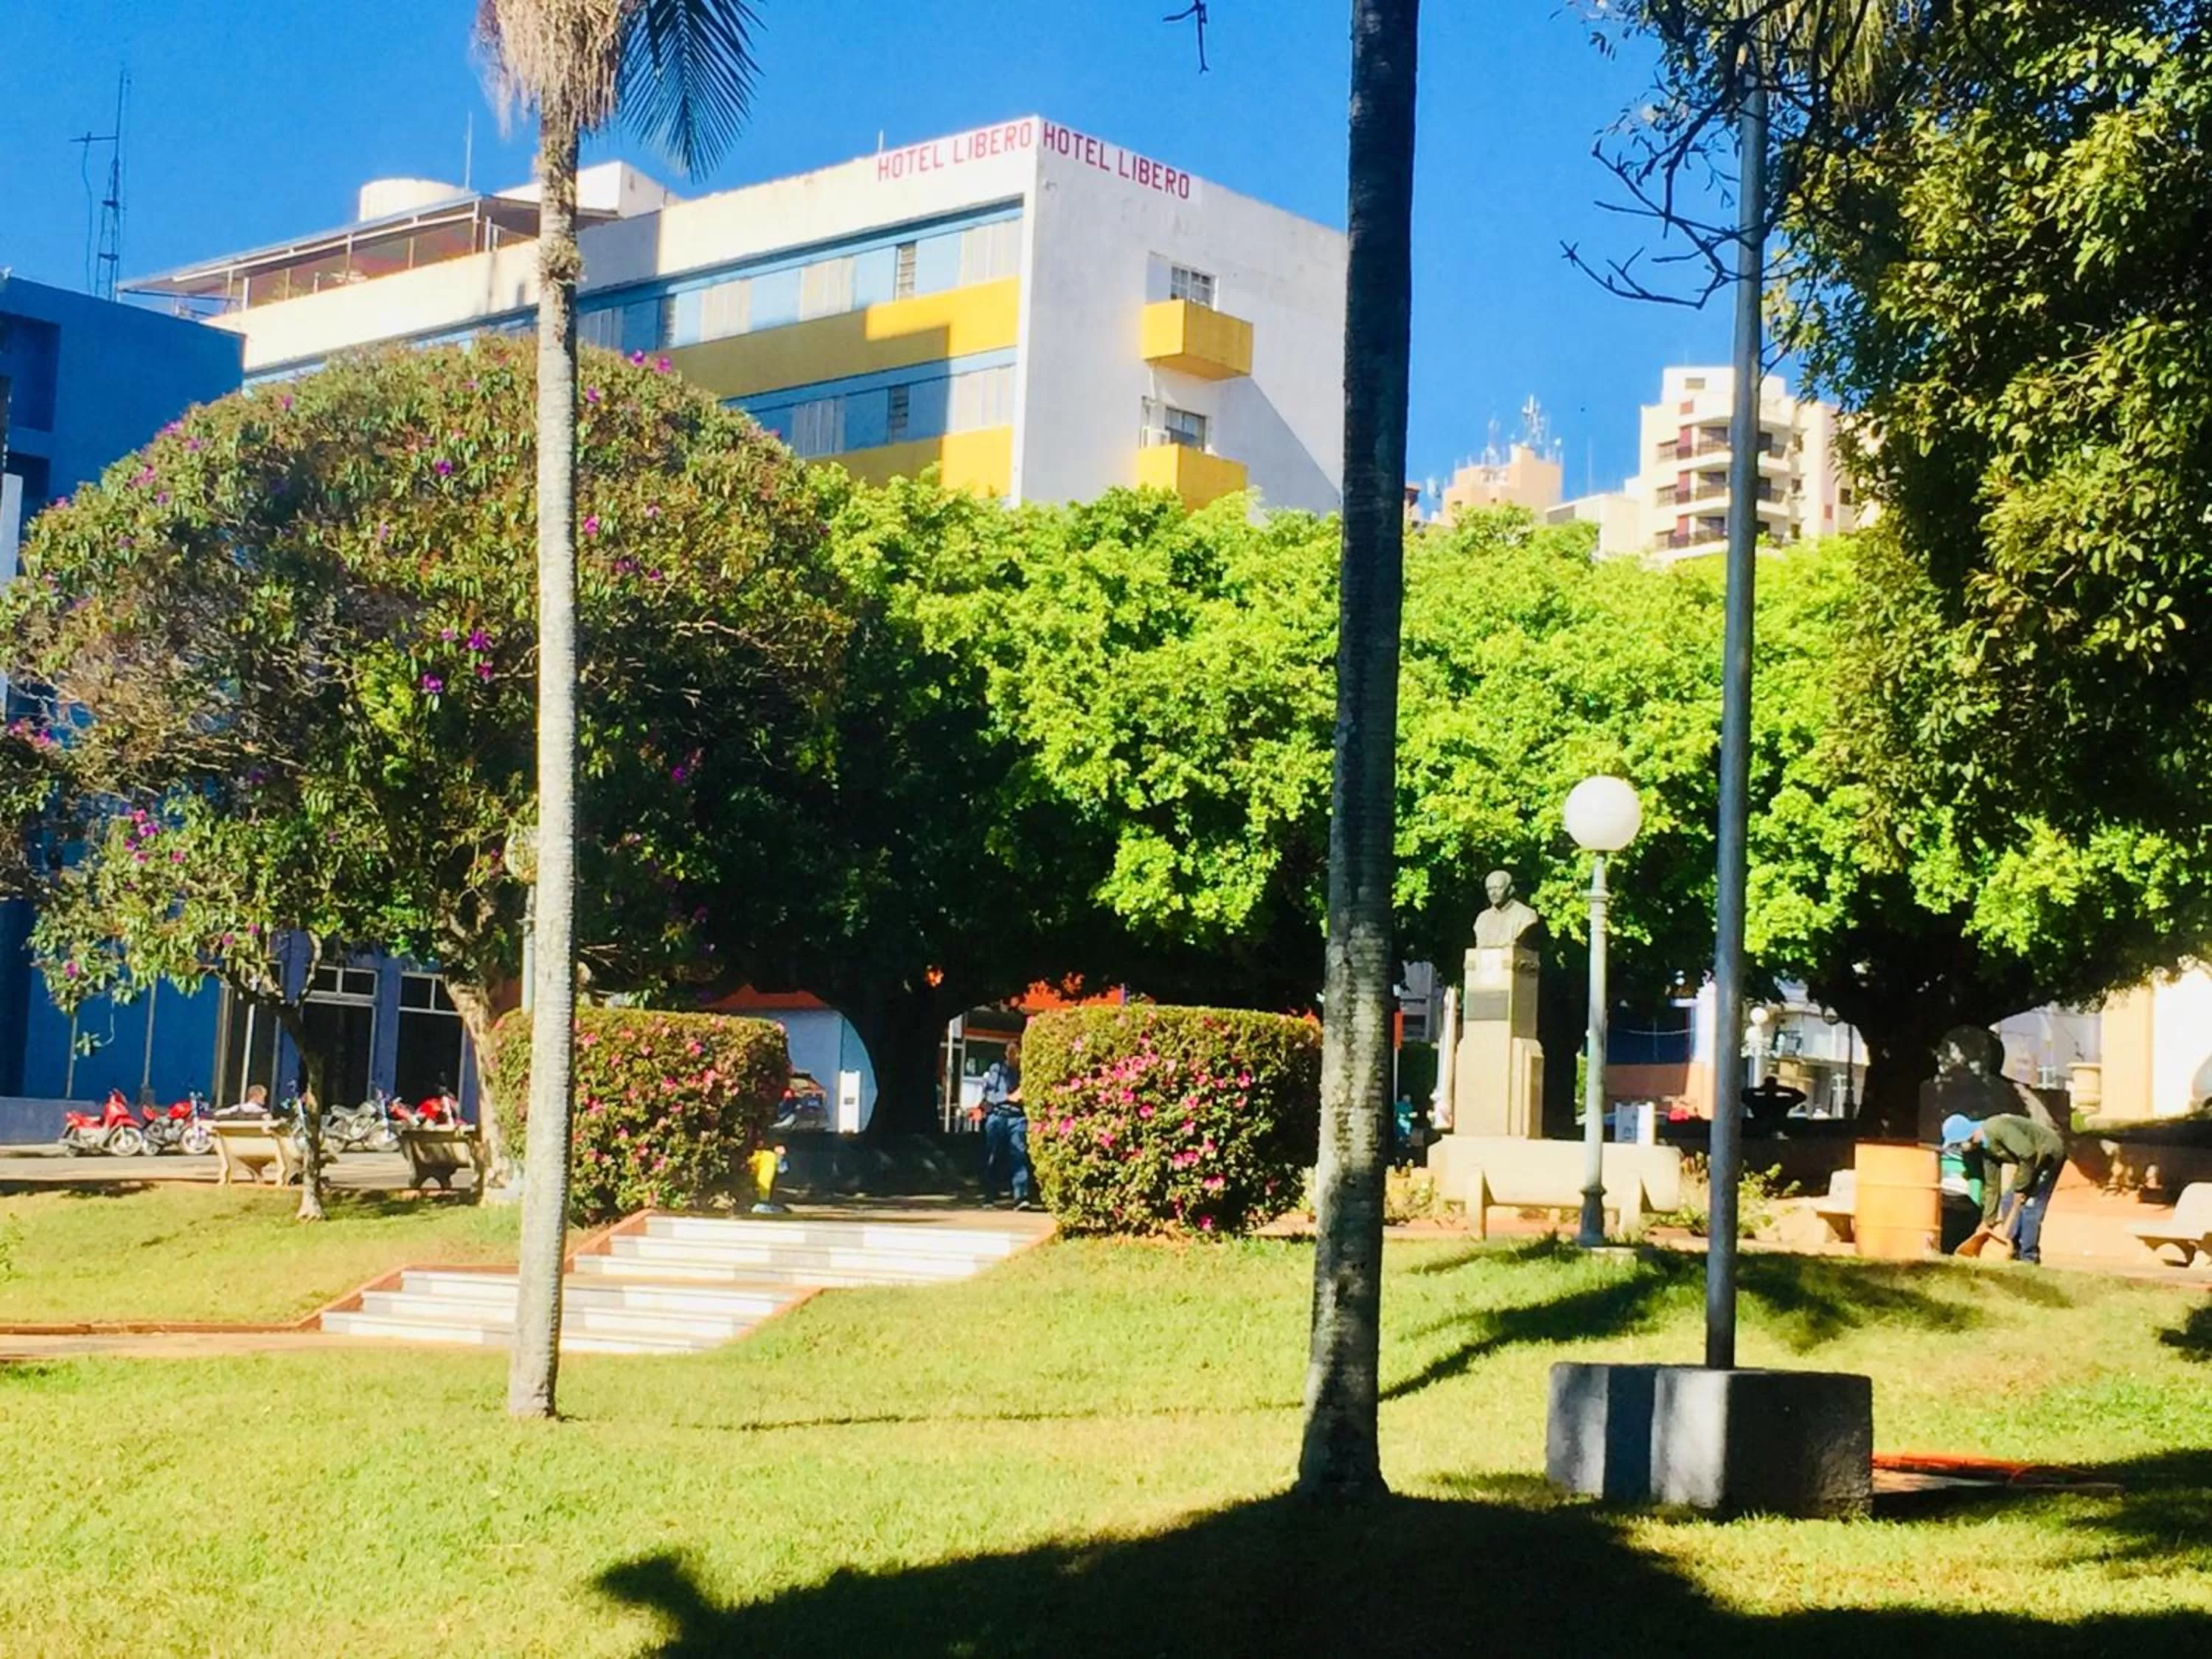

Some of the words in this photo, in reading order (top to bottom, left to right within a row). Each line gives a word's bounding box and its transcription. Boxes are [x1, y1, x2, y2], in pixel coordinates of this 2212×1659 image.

[878, 145, 945, 181] HOTEL
[953, 122, 1032, 164] LIBERO
[1043, 122, 1110, 173] HOTEL
[1118, 150, 1191, 200] LIBERO
